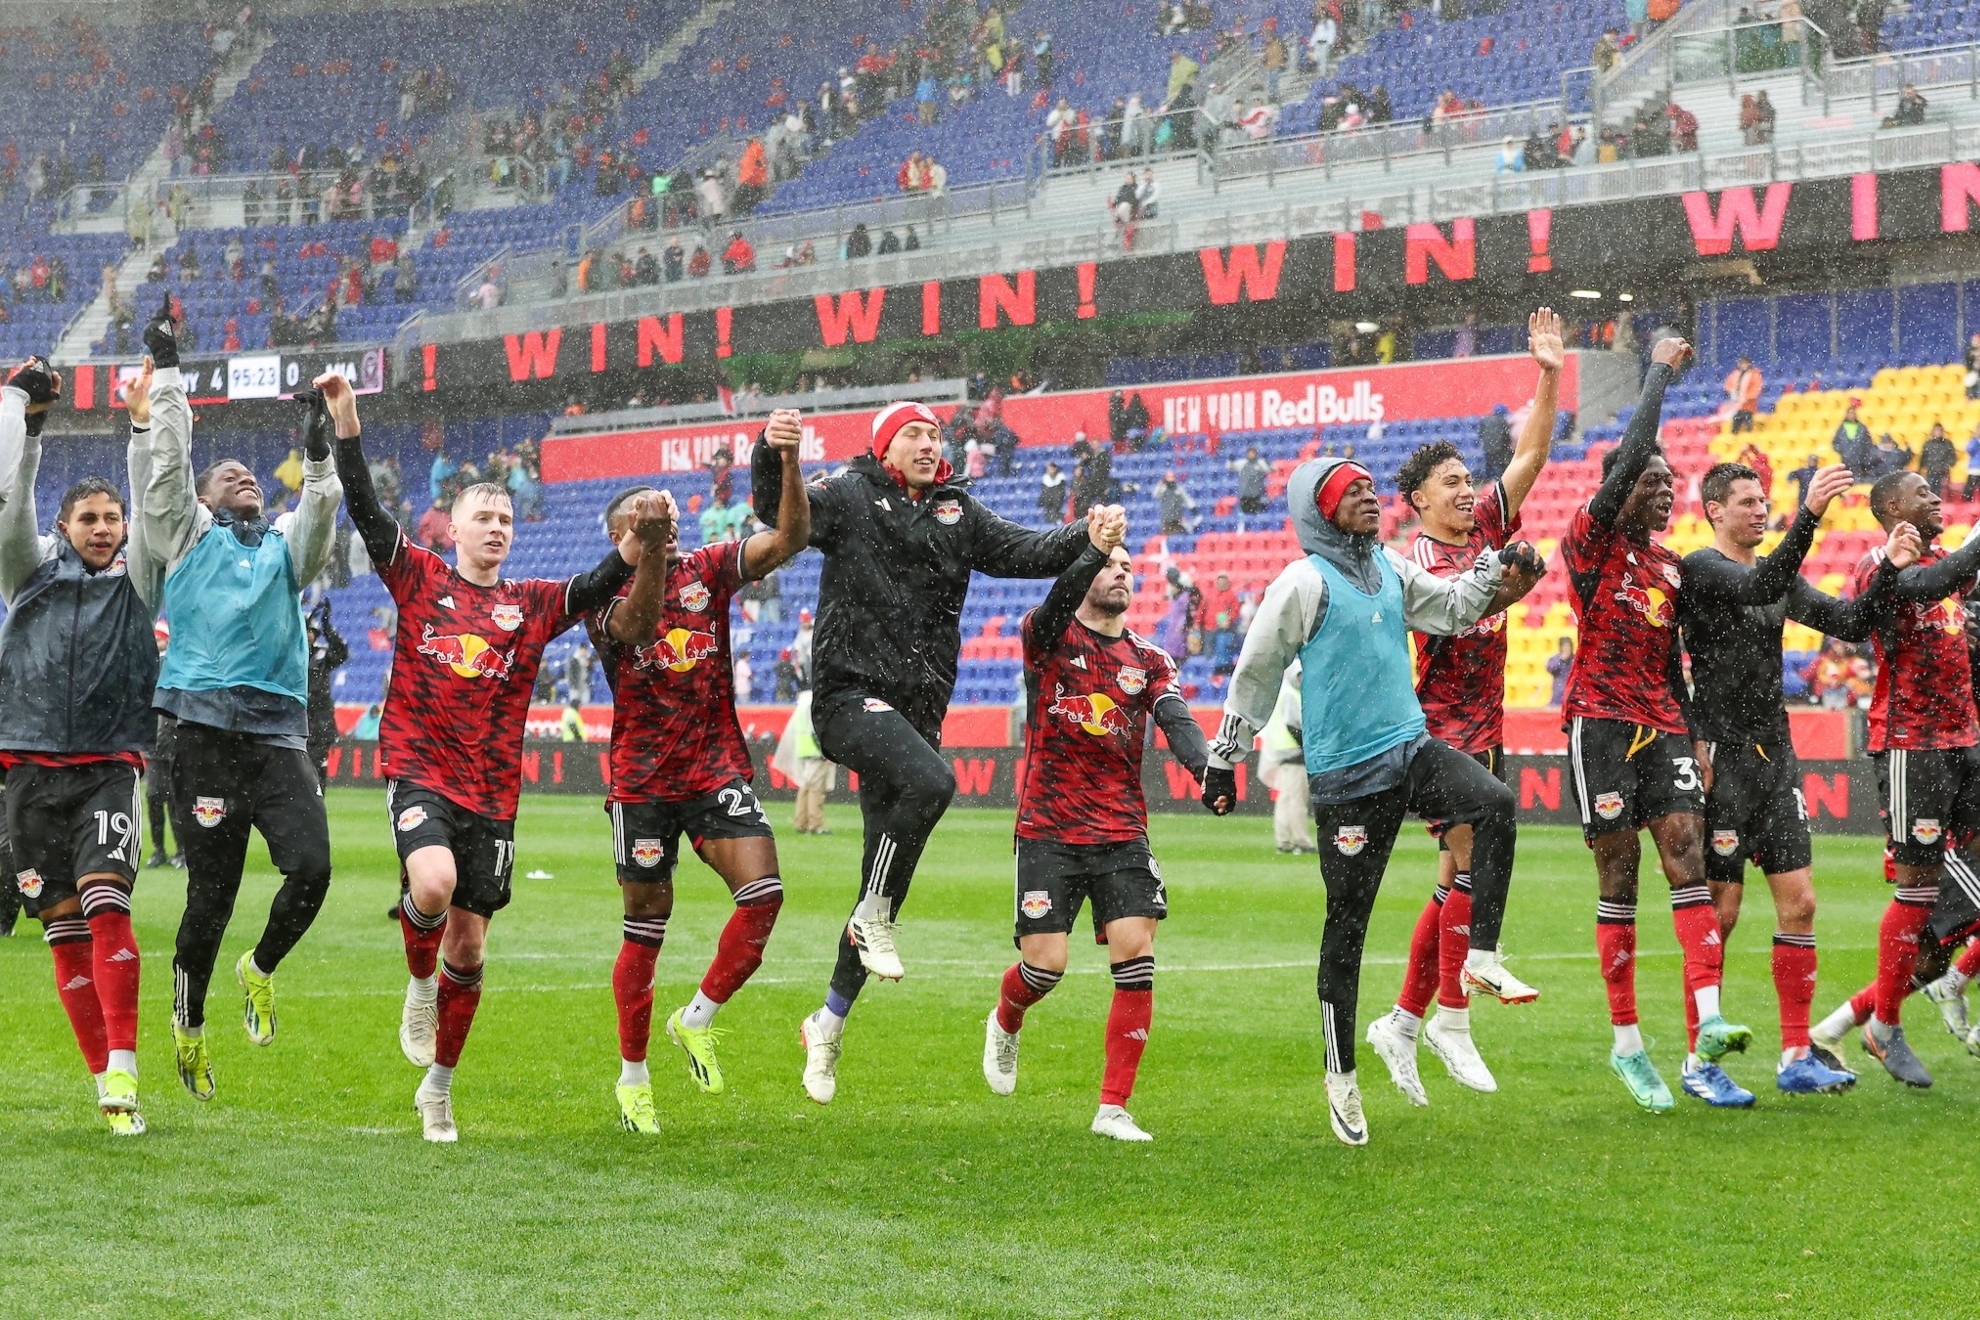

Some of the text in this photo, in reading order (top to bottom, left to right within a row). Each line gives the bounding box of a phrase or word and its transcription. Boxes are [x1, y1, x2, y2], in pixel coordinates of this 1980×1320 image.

[503, 306, 734, 382] WIN!
[813, 260, 1097, 347] WIN!
[1198, 207, 1553, 306] WIN!
[210, 367, 224, 392] 4
[232, 367, 277, 389] 95:23
[286, 361, 300, 387] 0
[1671, 756, 1704, 792] 3
[93, 809, 133, 848] 19
